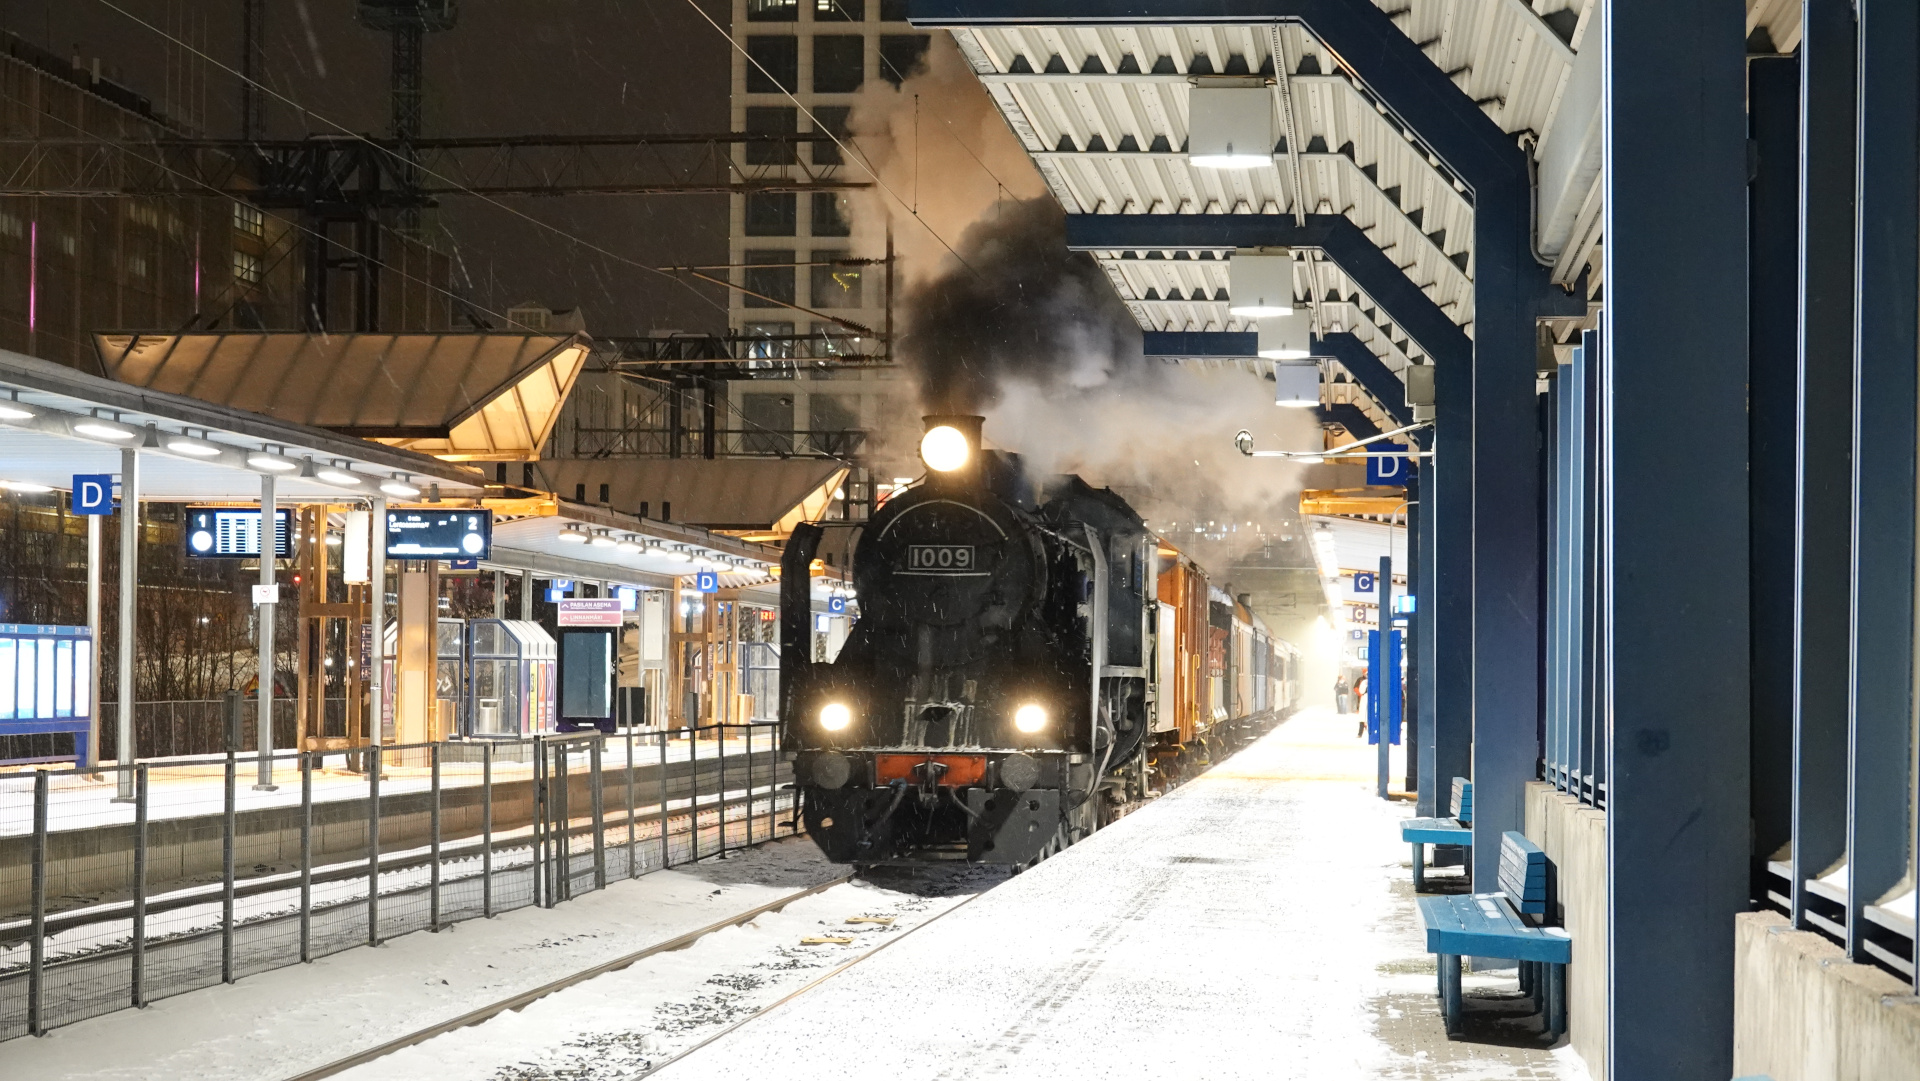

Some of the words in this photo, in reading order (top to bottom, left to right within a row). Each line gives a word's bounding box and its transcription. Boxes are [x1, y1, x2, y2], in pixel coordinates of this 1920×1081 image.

[1378, 453, 1399, 477] D
[82, 482, 103, 507] D
[198, 514, 206, 528] 1
[468, 516, 478, 530] 2
[913, 548, 970, 567] 1009
[701, 576, 713, 590] D
[1358, 576, 1370, 590] C
[831, 599, 842, 611] C
[1354, 608, 1364, 620] C
[1354, 630, 1361, 639] B
